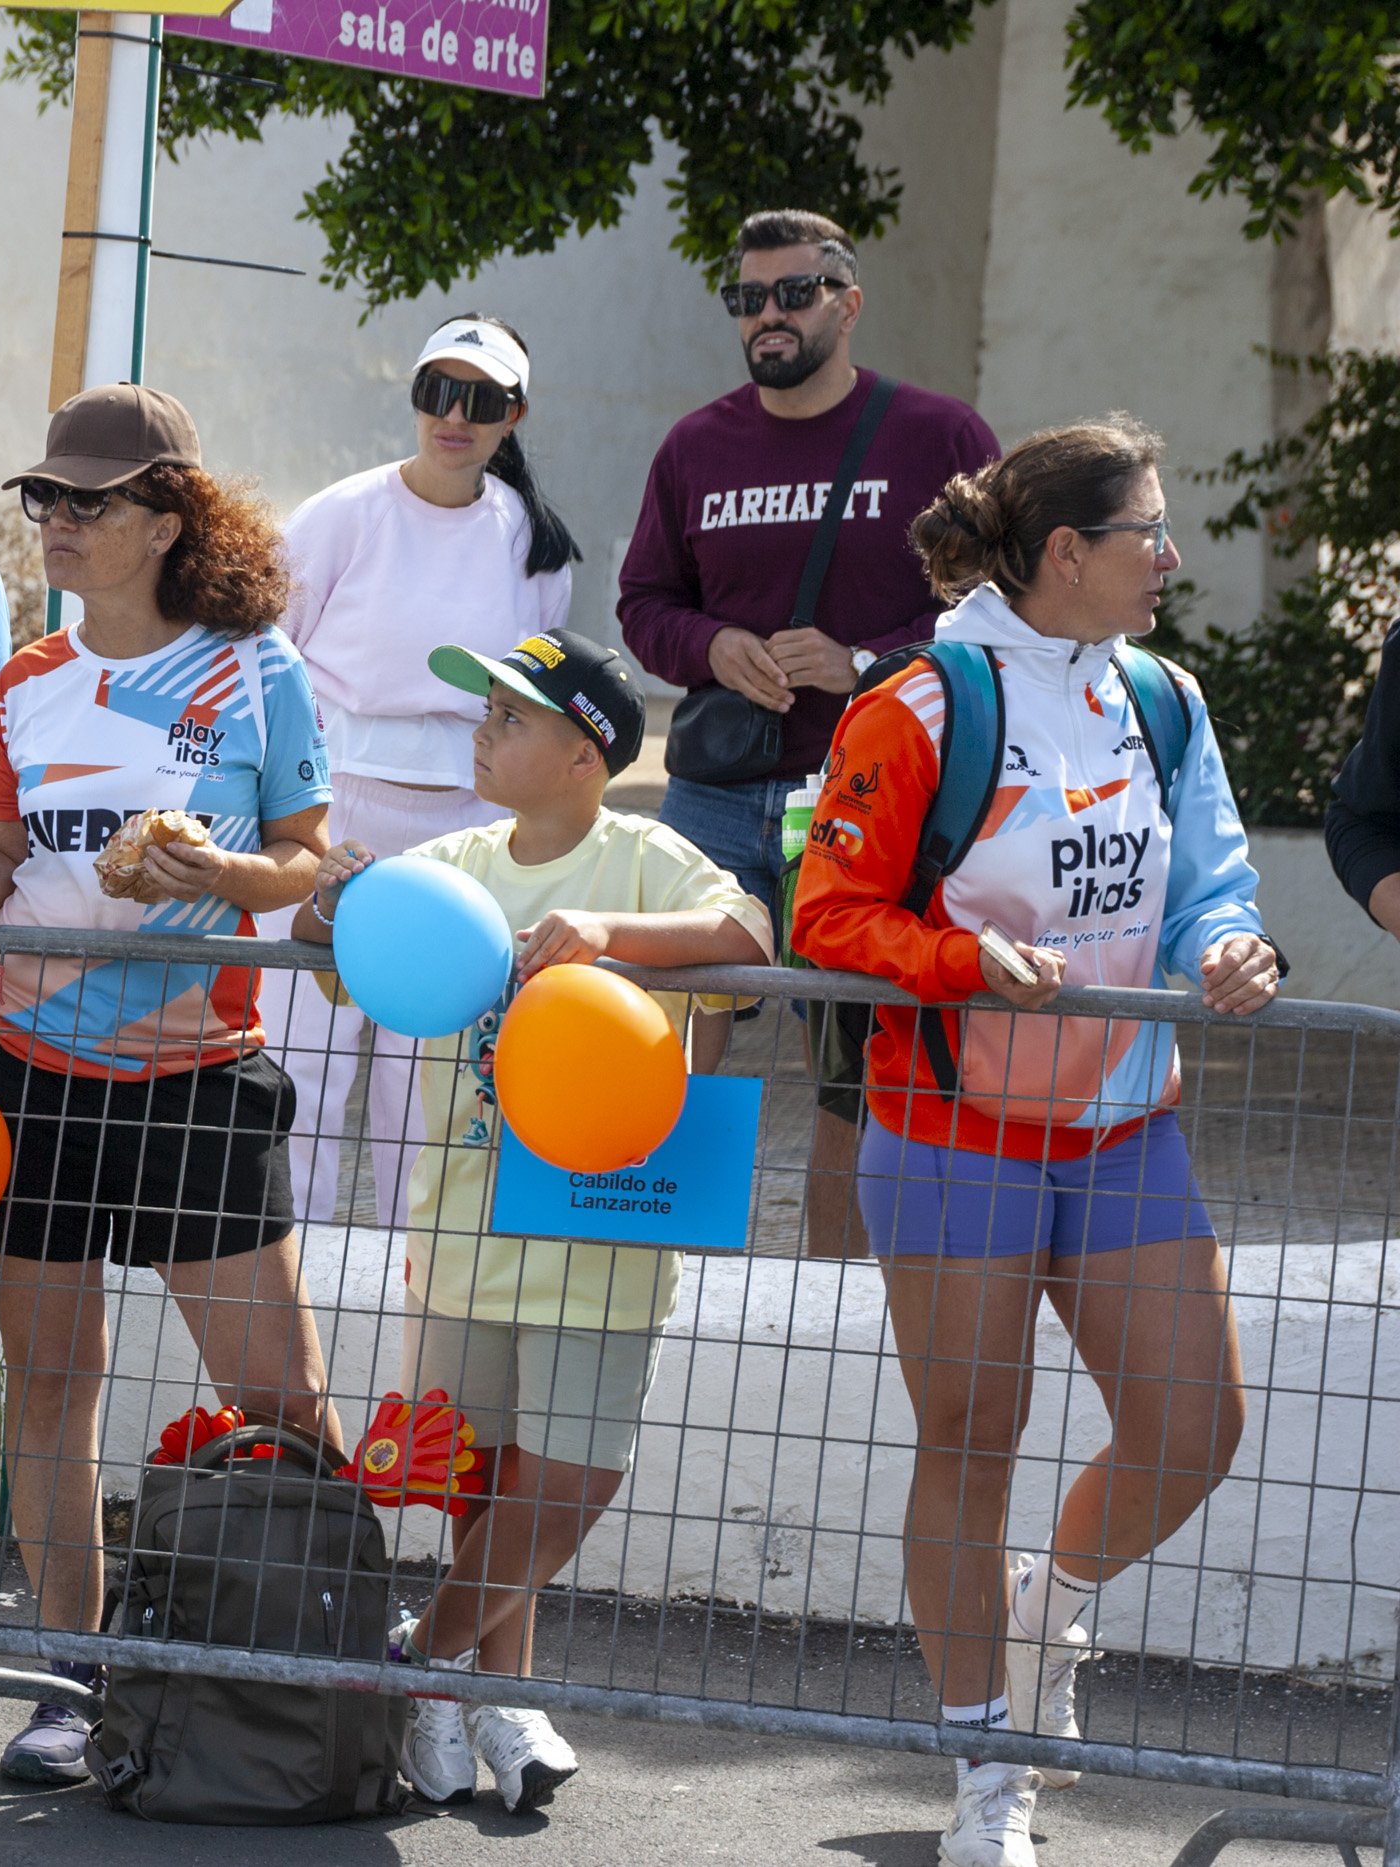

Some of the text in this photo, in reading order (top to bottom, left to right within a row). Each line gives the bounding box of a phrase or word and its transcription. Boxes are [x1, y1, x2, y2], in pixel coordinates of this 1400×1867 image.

[339, 6, 536, 79] sala de arte
[572, 691, 595, 715] RALLY
[591, 710, 605, 724] OF
[167, 718, 226, 752] play
[175, 741, 220, 766] itas
[180, 770, 202, 779] your
[1051, 824, 1150, 888] play
[1067, 876, 1145, 918] itas
[1074, 930, 1115, 949] your
[1123, 921, 1151, 937] min
[568, 1171, 678, 1194] Cabildo de
[570, 1191, 672, 1215] Lanzarote
